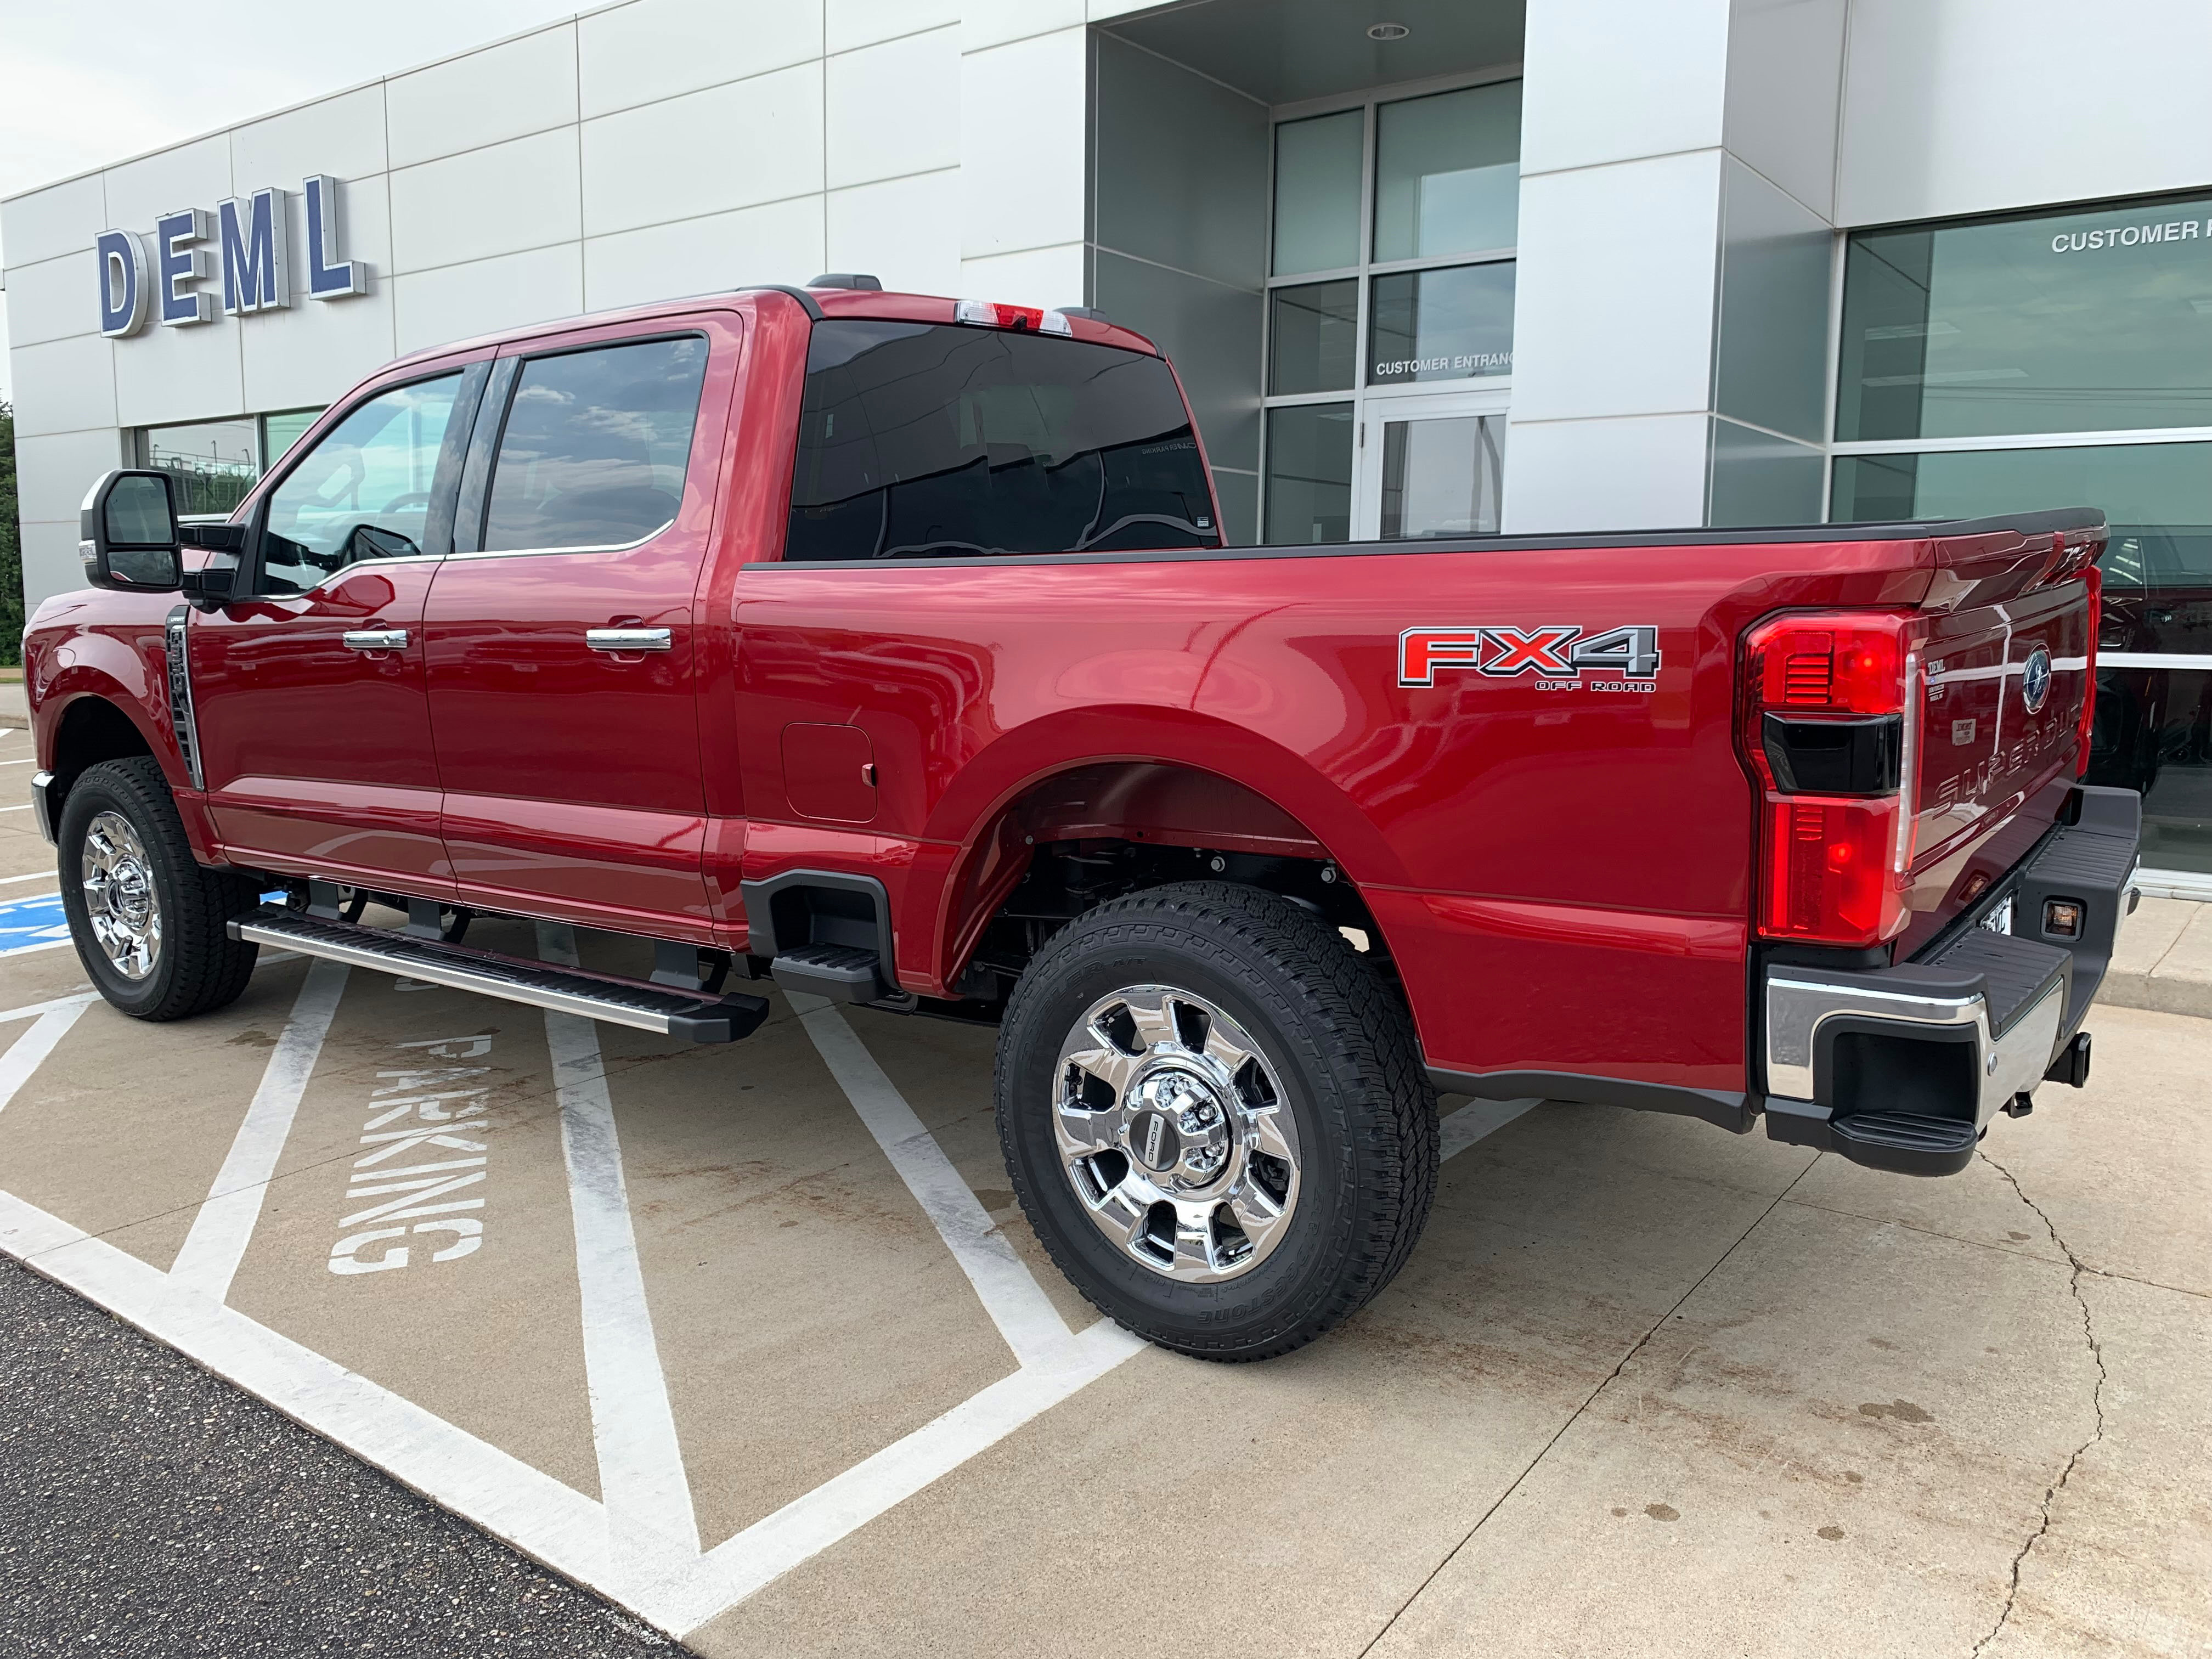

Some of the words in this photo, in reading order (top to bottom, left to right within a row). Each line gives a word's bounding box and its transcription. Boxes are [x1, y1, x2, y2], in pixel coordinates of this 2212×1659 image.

[95, 174, 366, 338] DEML
[2052, 220, 2198, 252] CUSTOMER
[1376, 357, 1449, 375] CUSTOMER
[1398, 625, 1661, 688] FX4
[1928, 659, 1945, 675] DEML
[1535, 680, 1582, 691] OFF
[1590, 681, 1656, 693] ROAD
[1932, 728, 2040, 821] SUPER
[328, 1035, 492, 1275] PARKING
[1148, 1121, 1159, 1162] FORD
